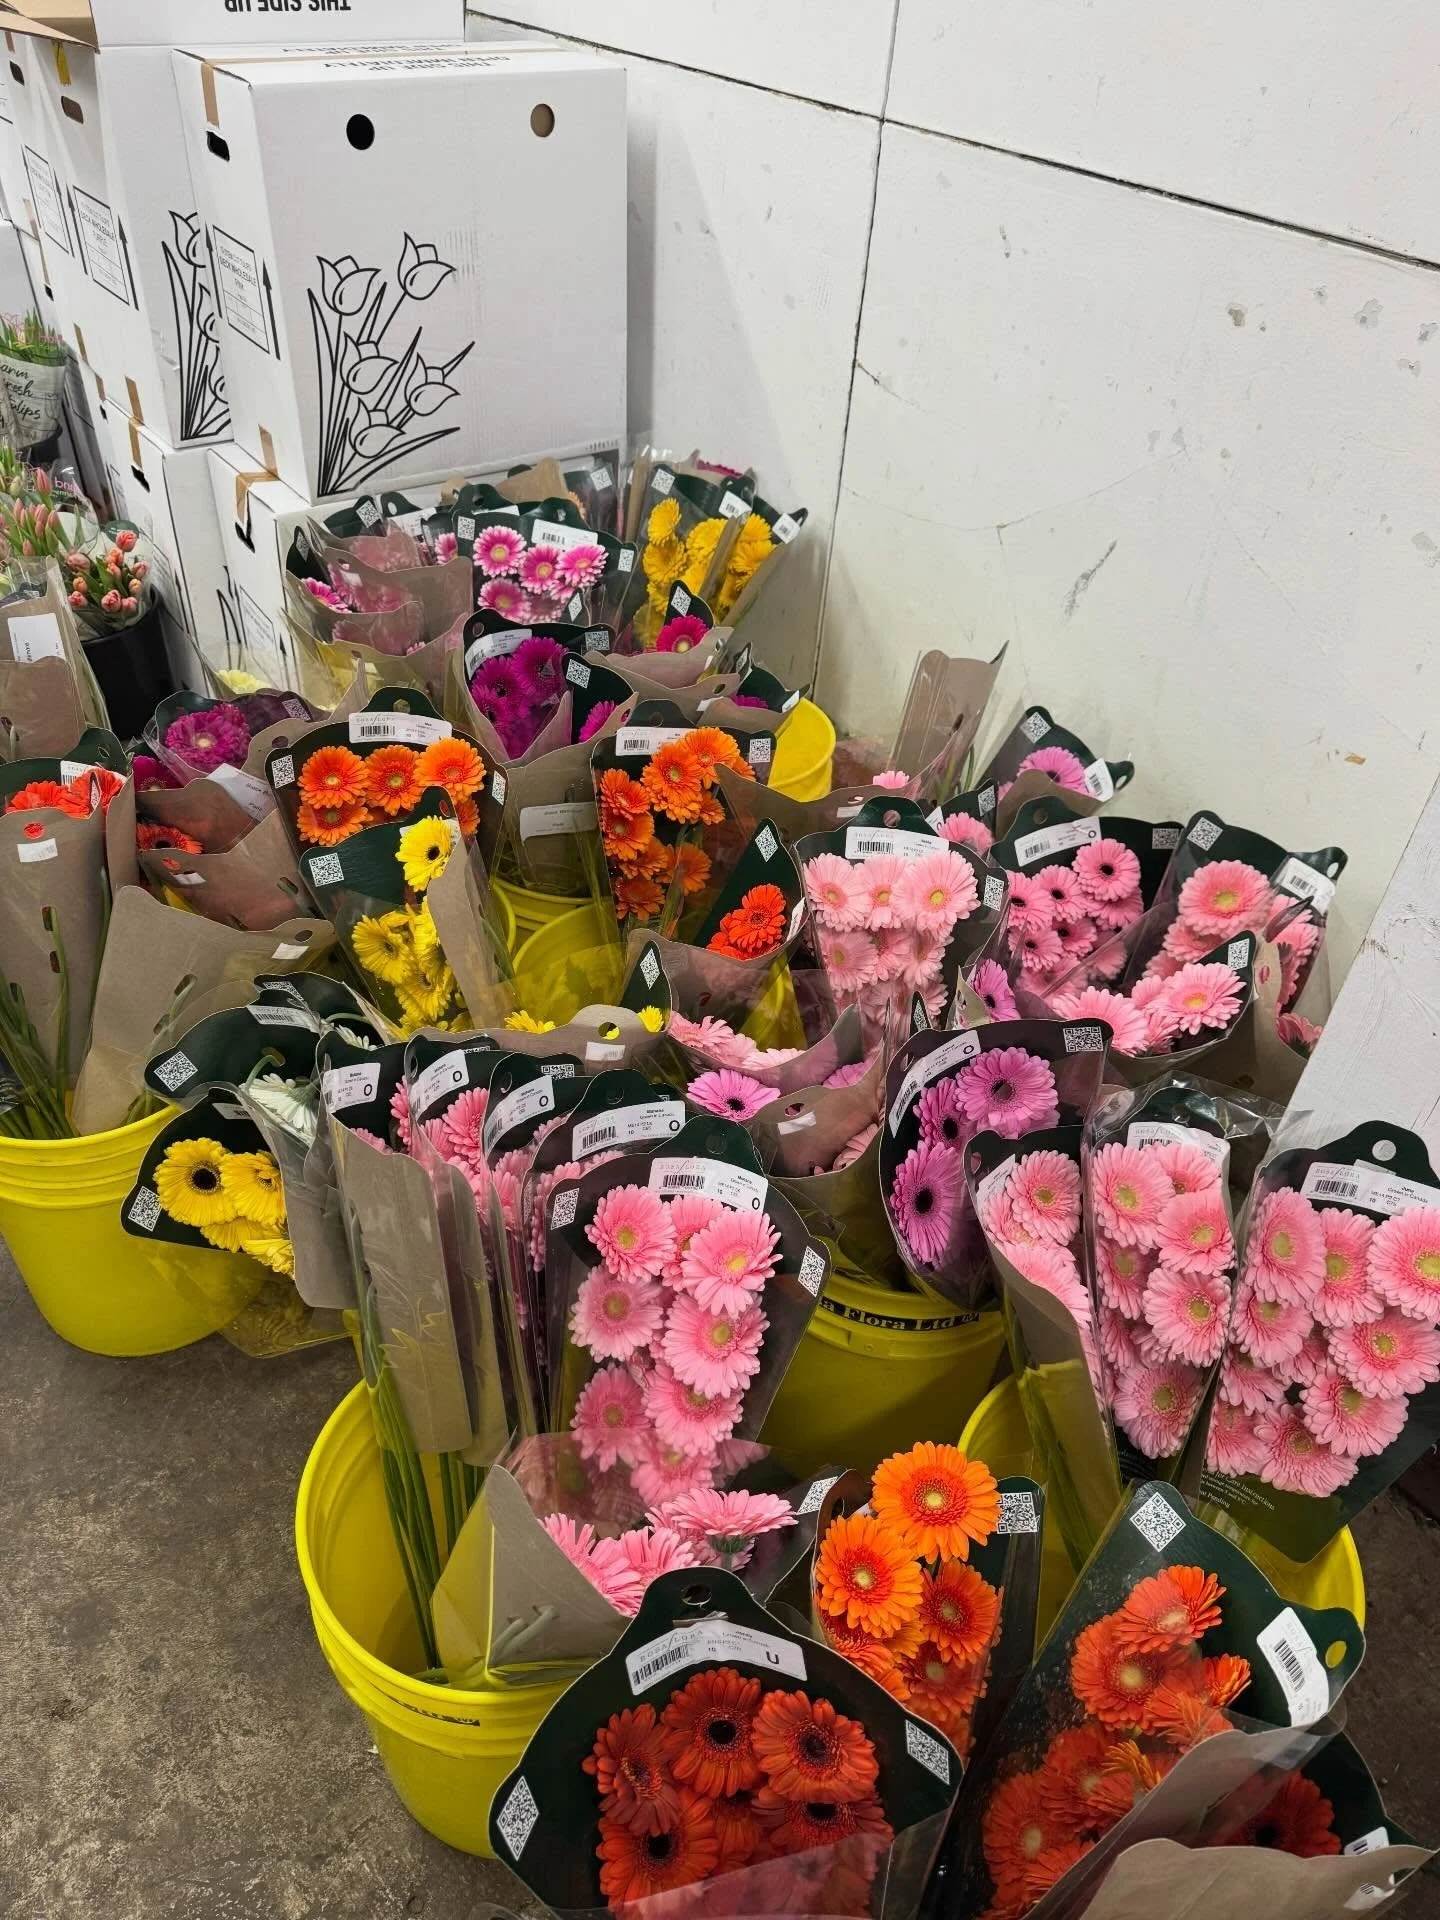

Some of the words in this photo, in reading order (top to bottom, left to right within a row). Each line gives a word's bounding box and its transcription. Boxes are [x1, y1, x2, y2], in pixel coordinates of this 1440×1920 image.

[224, 0, 251, 12] UP
[258, 0, 301, 11] SIDE
[308, 0, 351, 11] THIS
[0, 364, 29, 380] arm
[5, 380, 33, 397] resh
[844, 1304, 905, 1330] Flora
[915, 1318, 954, 1330] Ltd
[1207, 1492, 1231, 1508] Pending
[1241, 1484, 1275, 1511] Instructions
